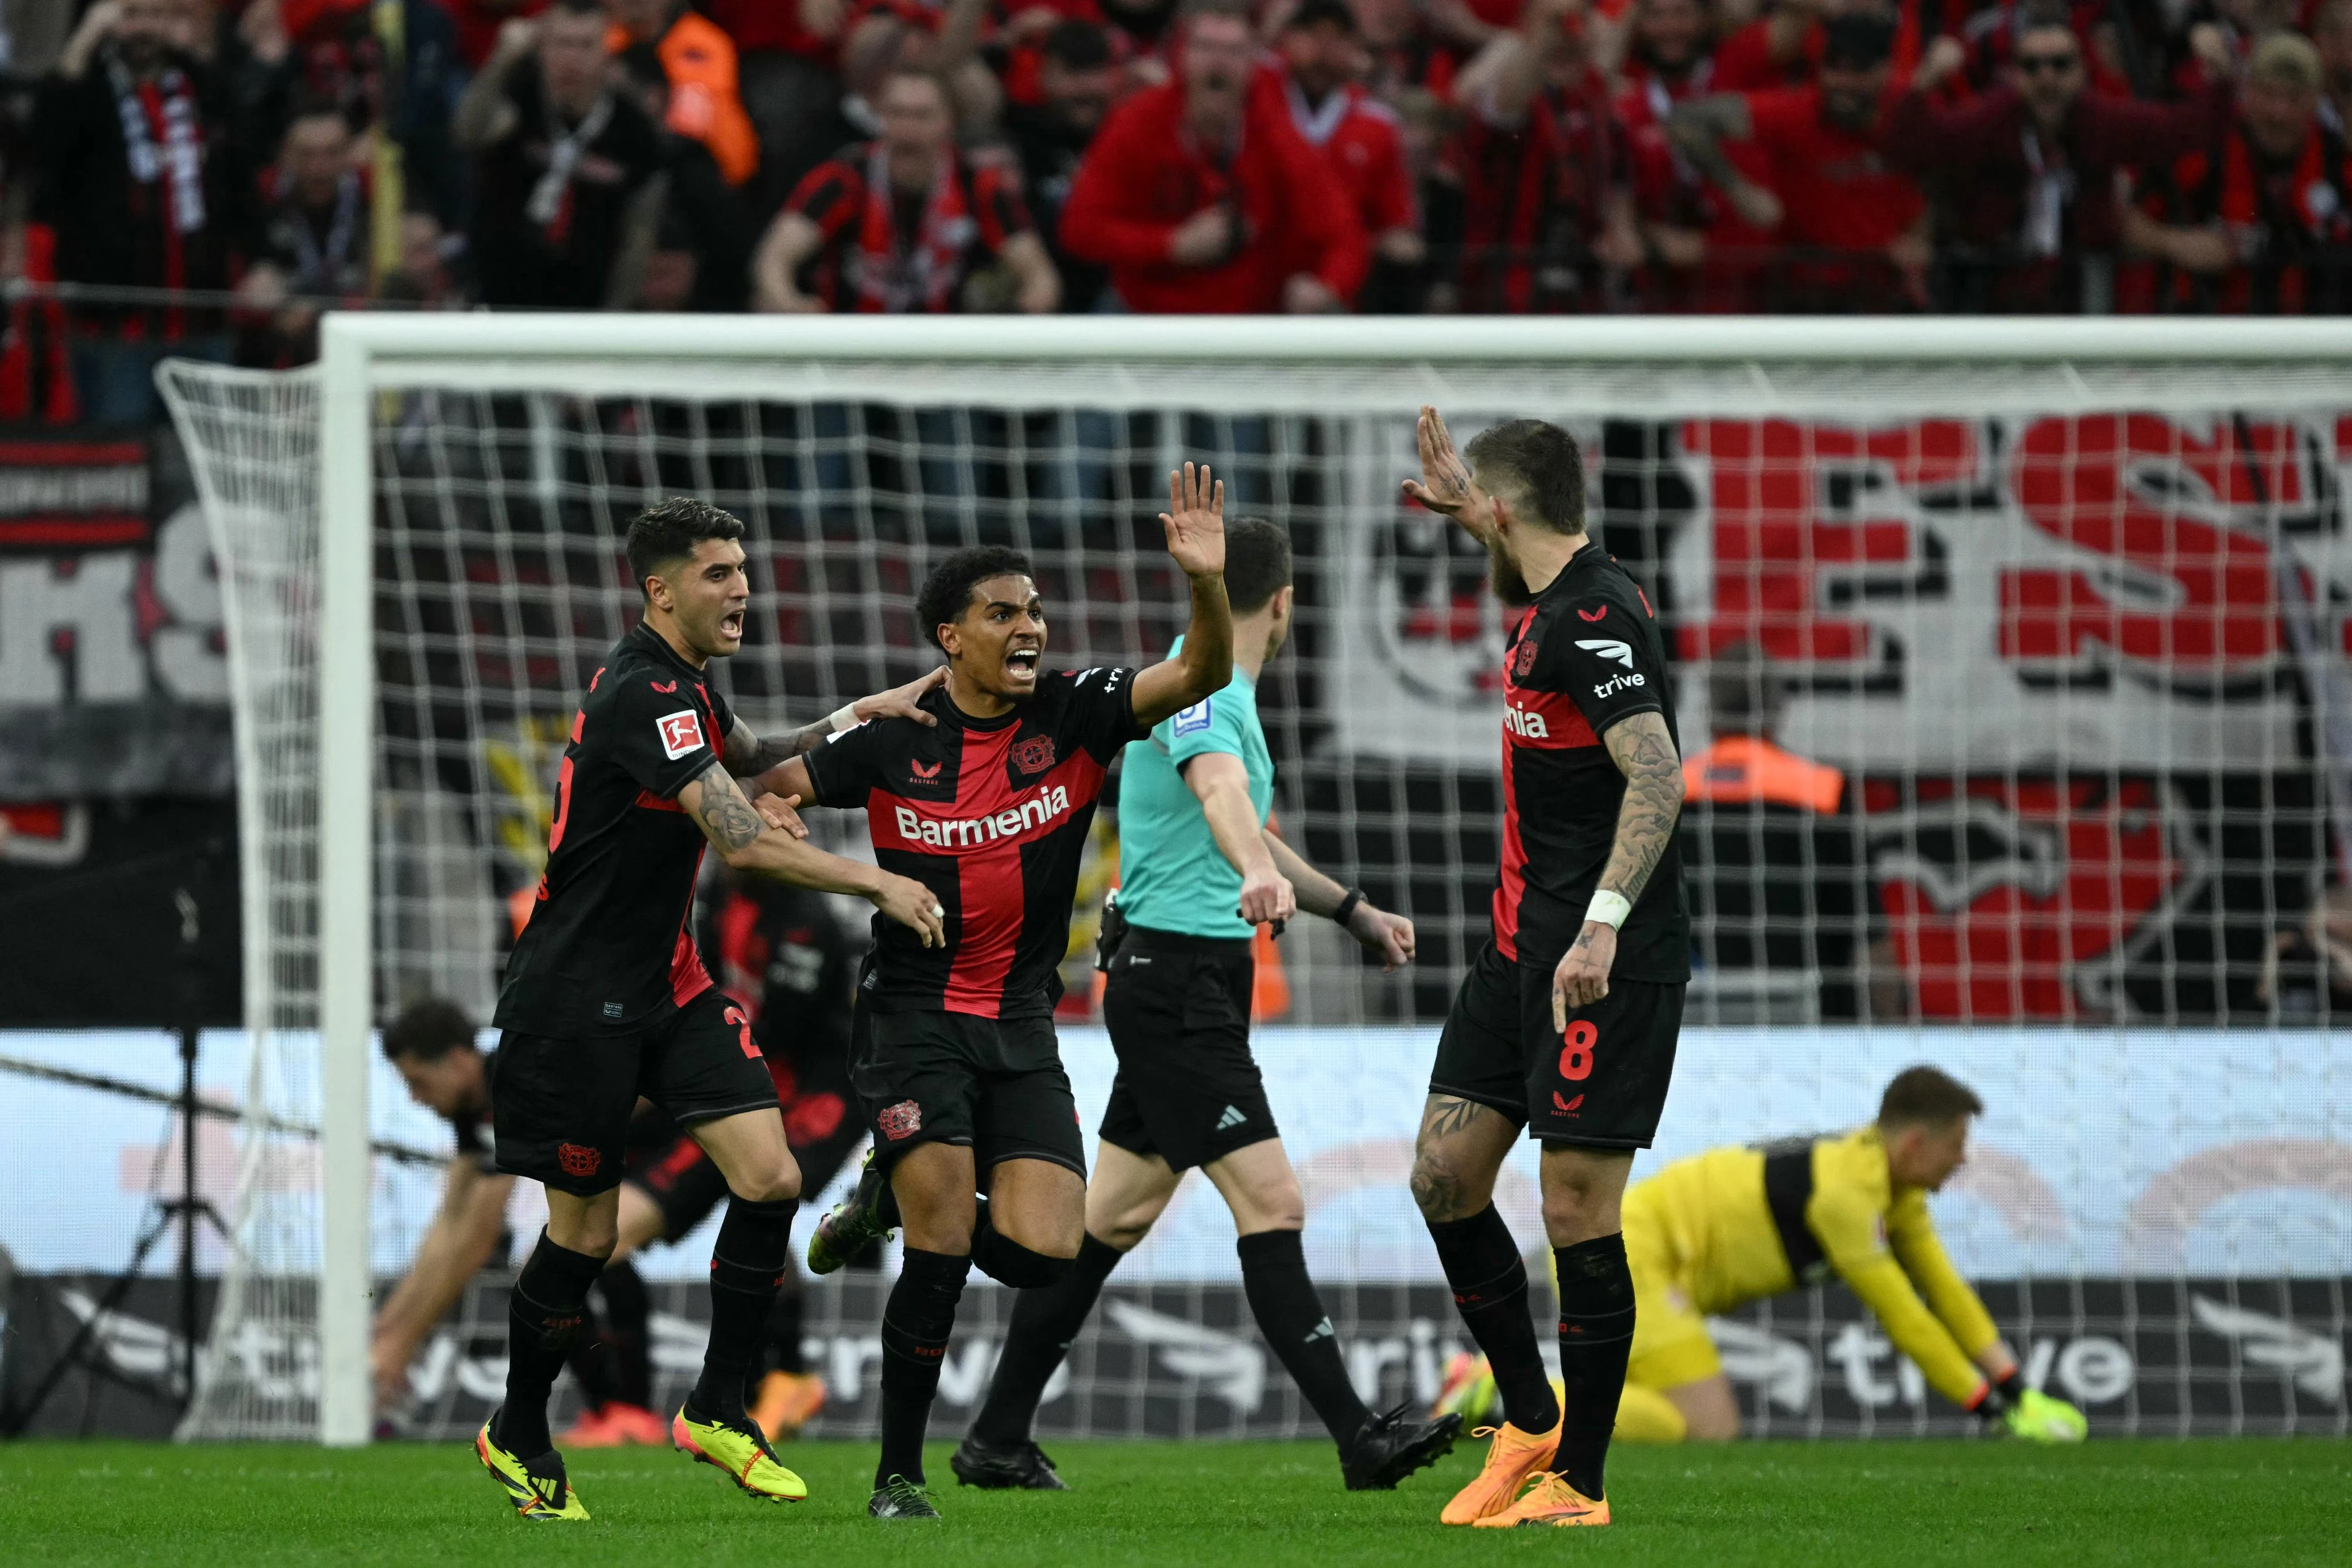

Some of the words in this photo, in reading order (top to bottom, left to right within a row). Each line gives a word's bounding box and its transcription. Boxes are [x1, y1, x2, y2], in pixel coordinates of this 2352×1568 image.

[1594, 673, 1645, 698] trive
[895, 785, 1070, 846] Barmenia
[1559, 1020, 1598, 1081] 8
